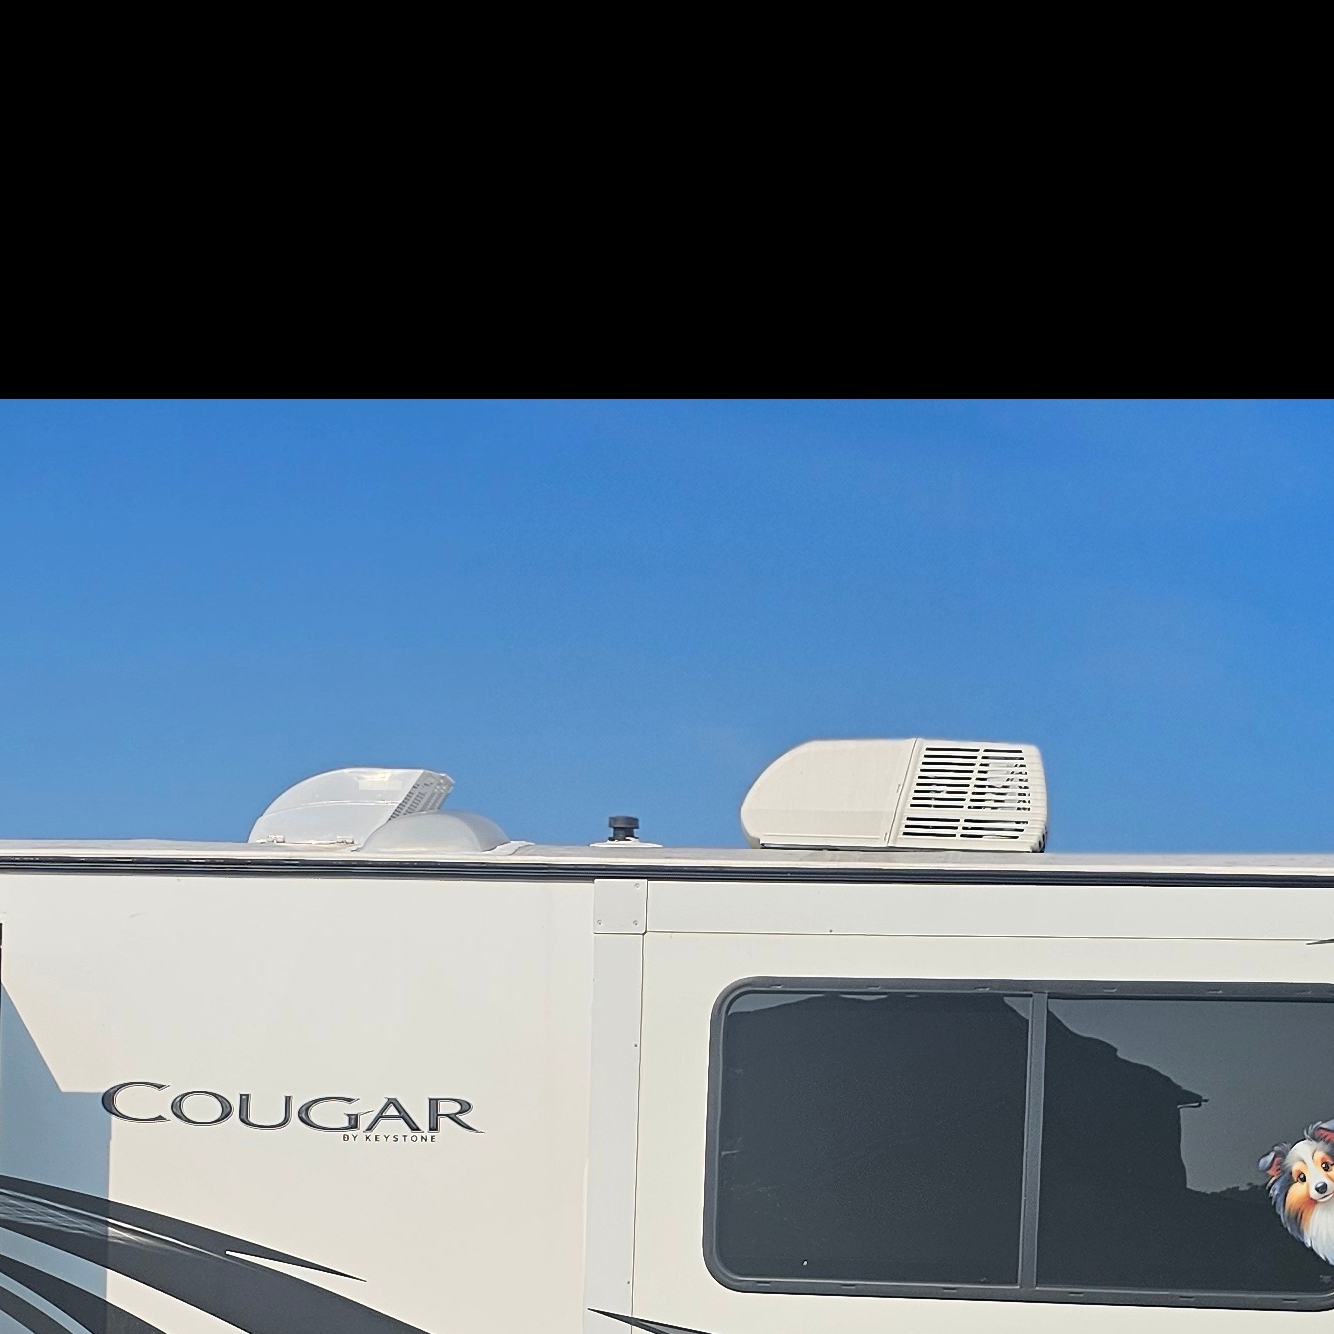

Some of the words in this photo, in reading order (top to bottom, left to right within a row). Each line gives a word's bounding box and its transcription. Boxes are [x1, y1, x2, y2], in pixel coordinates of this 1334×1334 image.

[101, 1081, 485, 1133] COUGAR
[342, 1134, 358, 1142] BY
[365, 1134, 436, 1143] KEYSTONE
